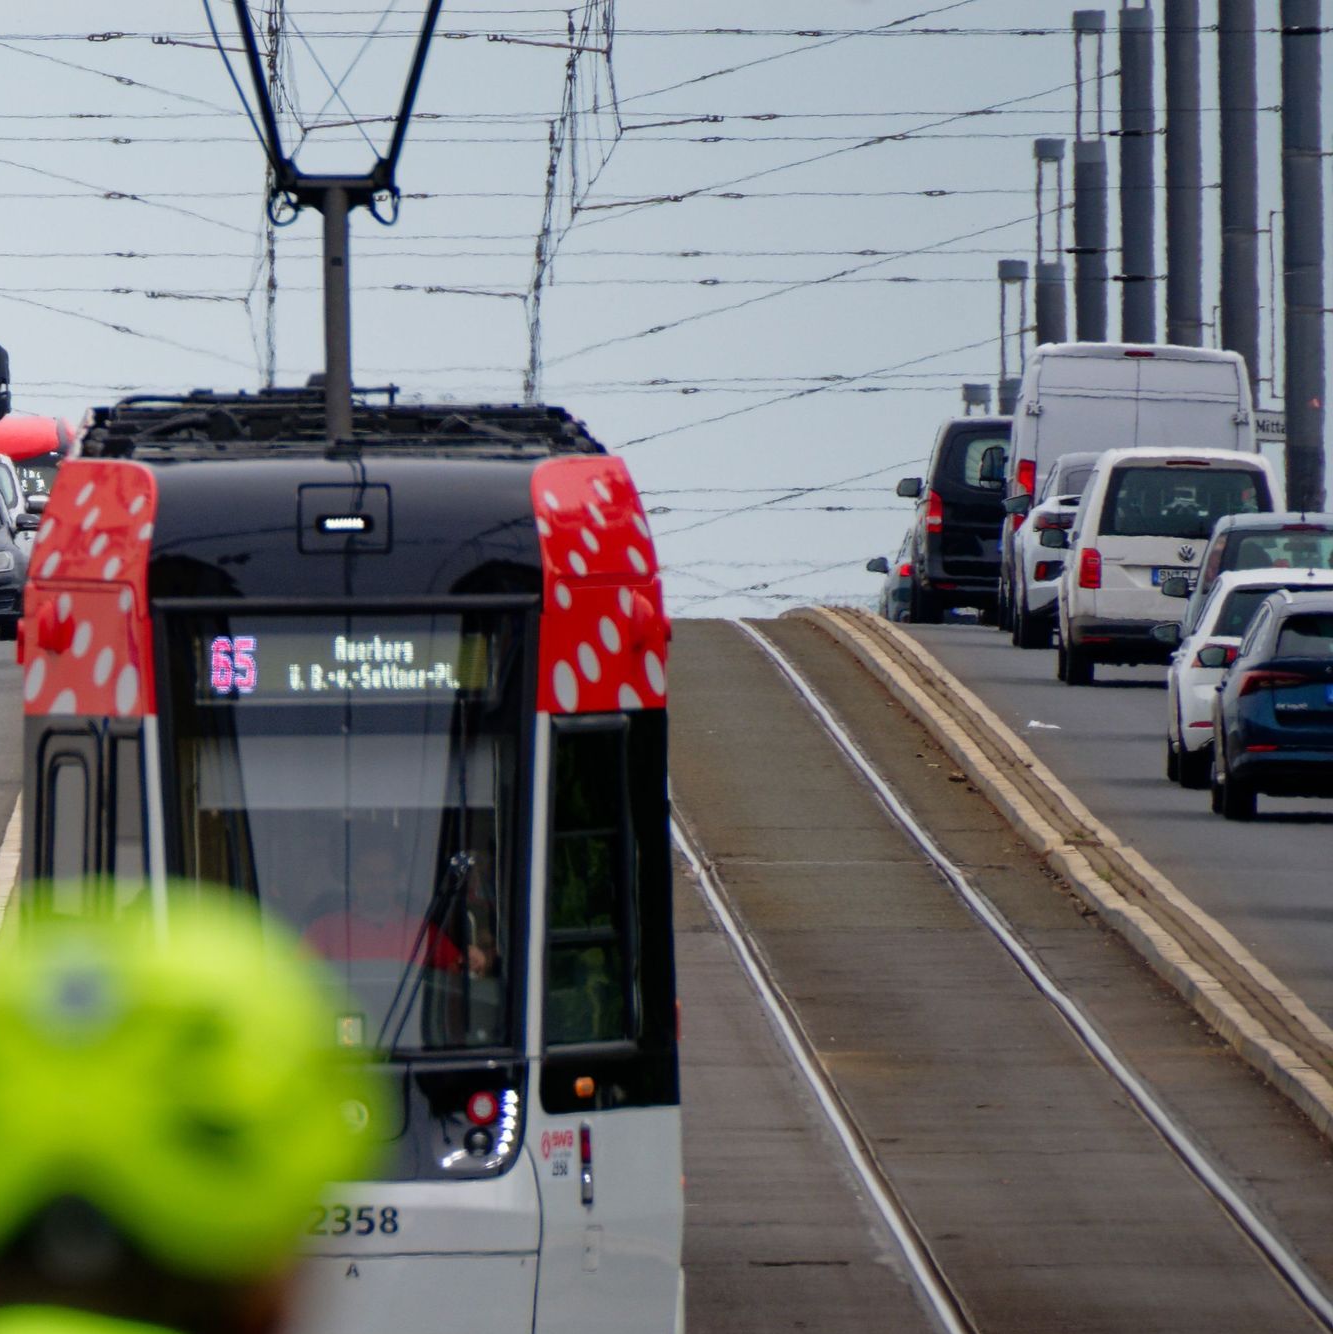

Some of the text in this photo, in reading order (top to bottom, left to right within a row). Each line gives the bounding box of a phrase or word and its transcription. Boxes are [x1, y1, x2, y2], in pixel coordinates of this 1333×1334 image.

[334, 635, 414, 663] Auerberg
[211, 636, 257, 694] 65
[307, 1205, 399, 1236] 2358
